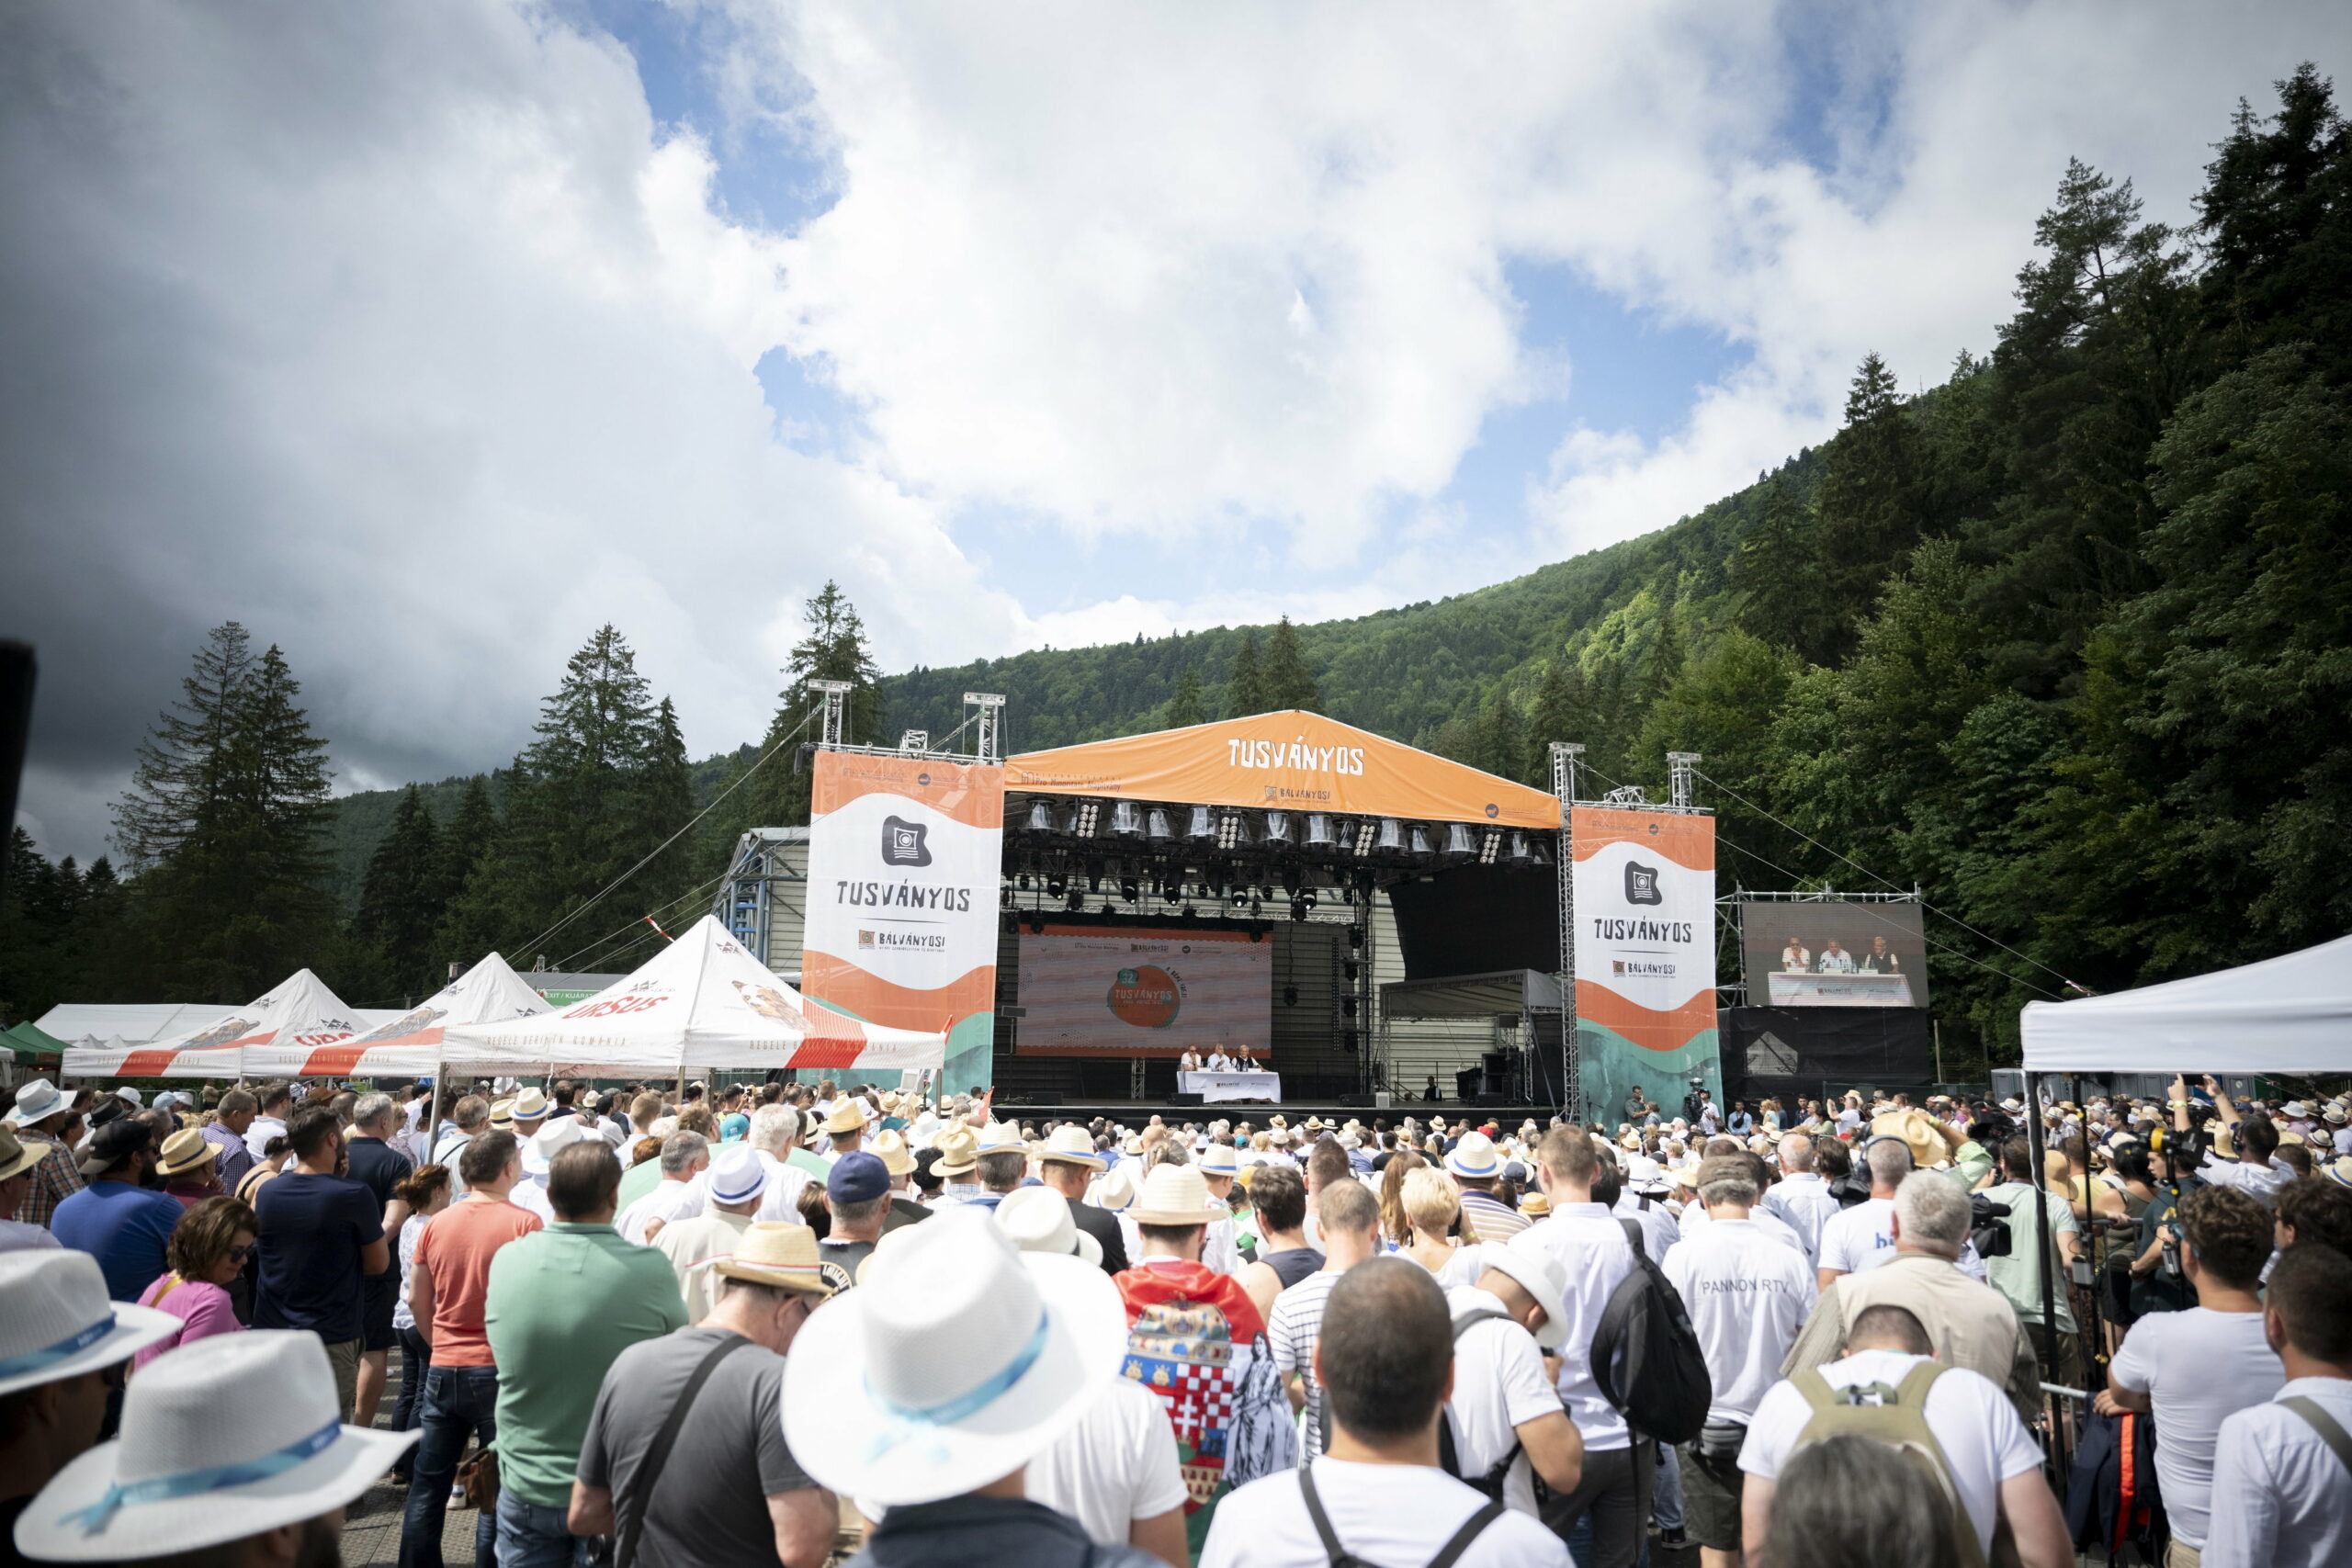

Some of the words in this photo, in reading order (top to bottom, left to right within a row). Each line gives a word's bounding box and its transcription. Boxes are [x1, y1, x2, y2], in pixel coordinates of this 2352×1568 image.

[1227, 734, 1364, 776] TUSVÁNYOS
[837, 878, 970, 912] TUSVÁNYOS
[1594, 915, 1691, 943] TUSVÁNYOS
[879, 931, 945, 948] BÁLVÁNYOSI
[1628, 960, 1676, 975] BÁLVÁNYOSI
[1115, 988, 1172, 1001] TUSVÁNYOS
[561, 996, 669, 1019] URSUS
[1702, 1278, 1758, 1294] PANNON
[1761, 1278, 1789, 1294] RTV
